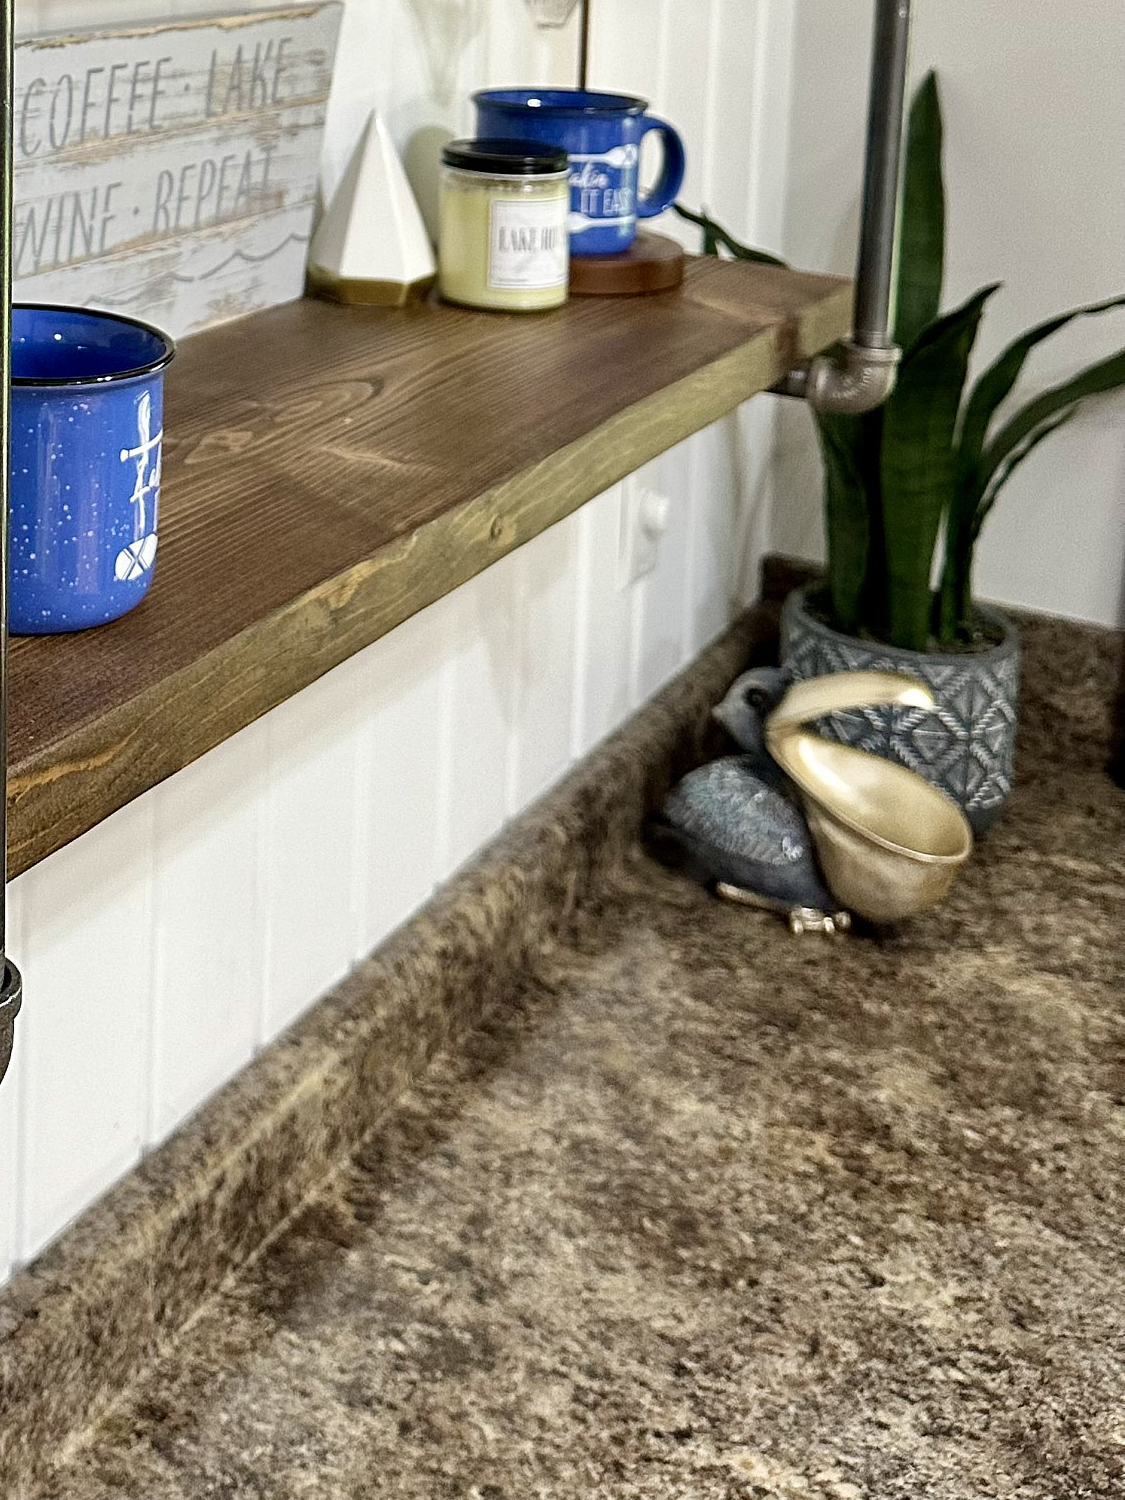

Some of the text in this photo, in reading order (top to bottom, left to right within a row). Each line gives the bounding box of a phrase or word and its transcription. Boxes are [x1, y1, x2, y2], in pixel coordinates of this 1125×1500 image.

[18, 36, 293, 157] COFFEE LAKE
[567, 160, 608, 189] akin
[602, 186, 635, 216] EAS
[13, 148, 275, 278] WINE REPEAT
